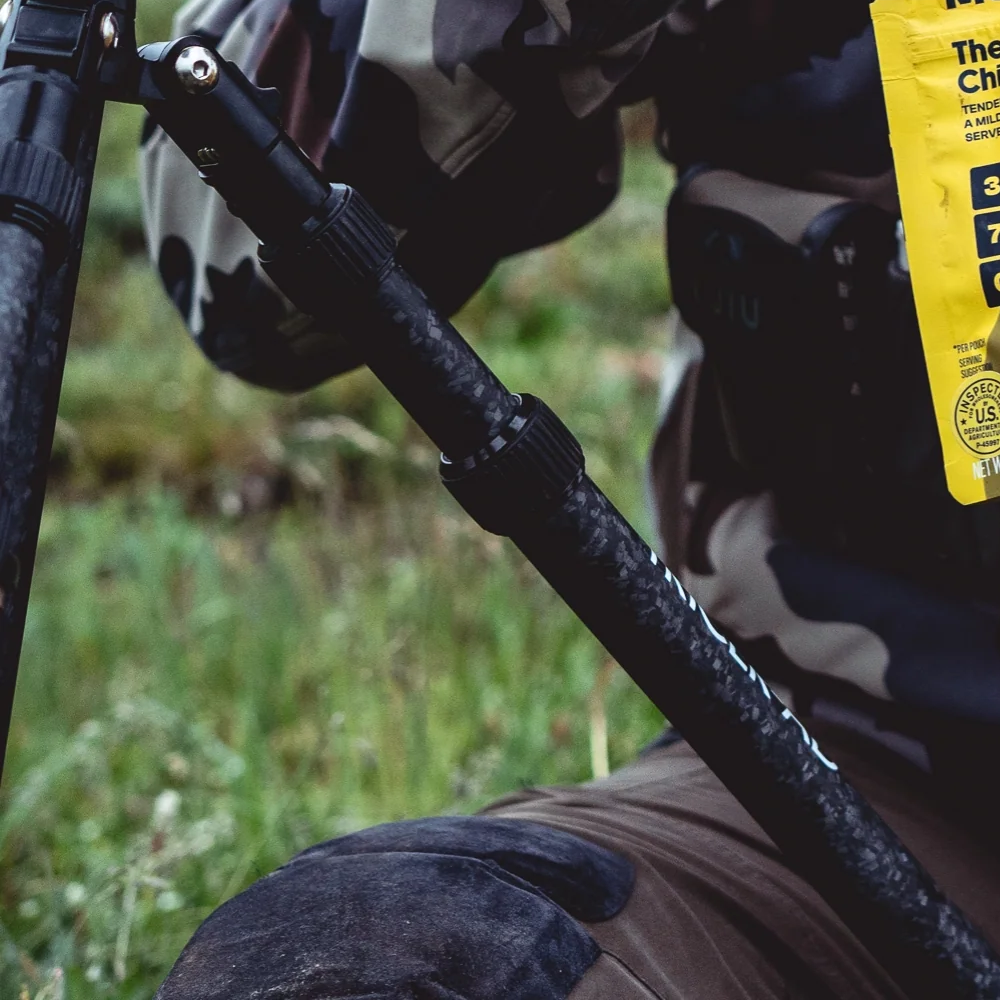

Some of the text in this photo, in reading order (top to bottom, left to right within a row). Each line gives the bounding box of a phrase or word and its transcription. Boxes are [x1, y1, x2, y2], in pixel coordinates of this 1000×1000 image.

[964, 119, 974, 129] A
[975, 405, 999, 424] U.S.
[963, 422, 1000, 435] DEPARTMENT
[972, 458, 991, 480] NET
